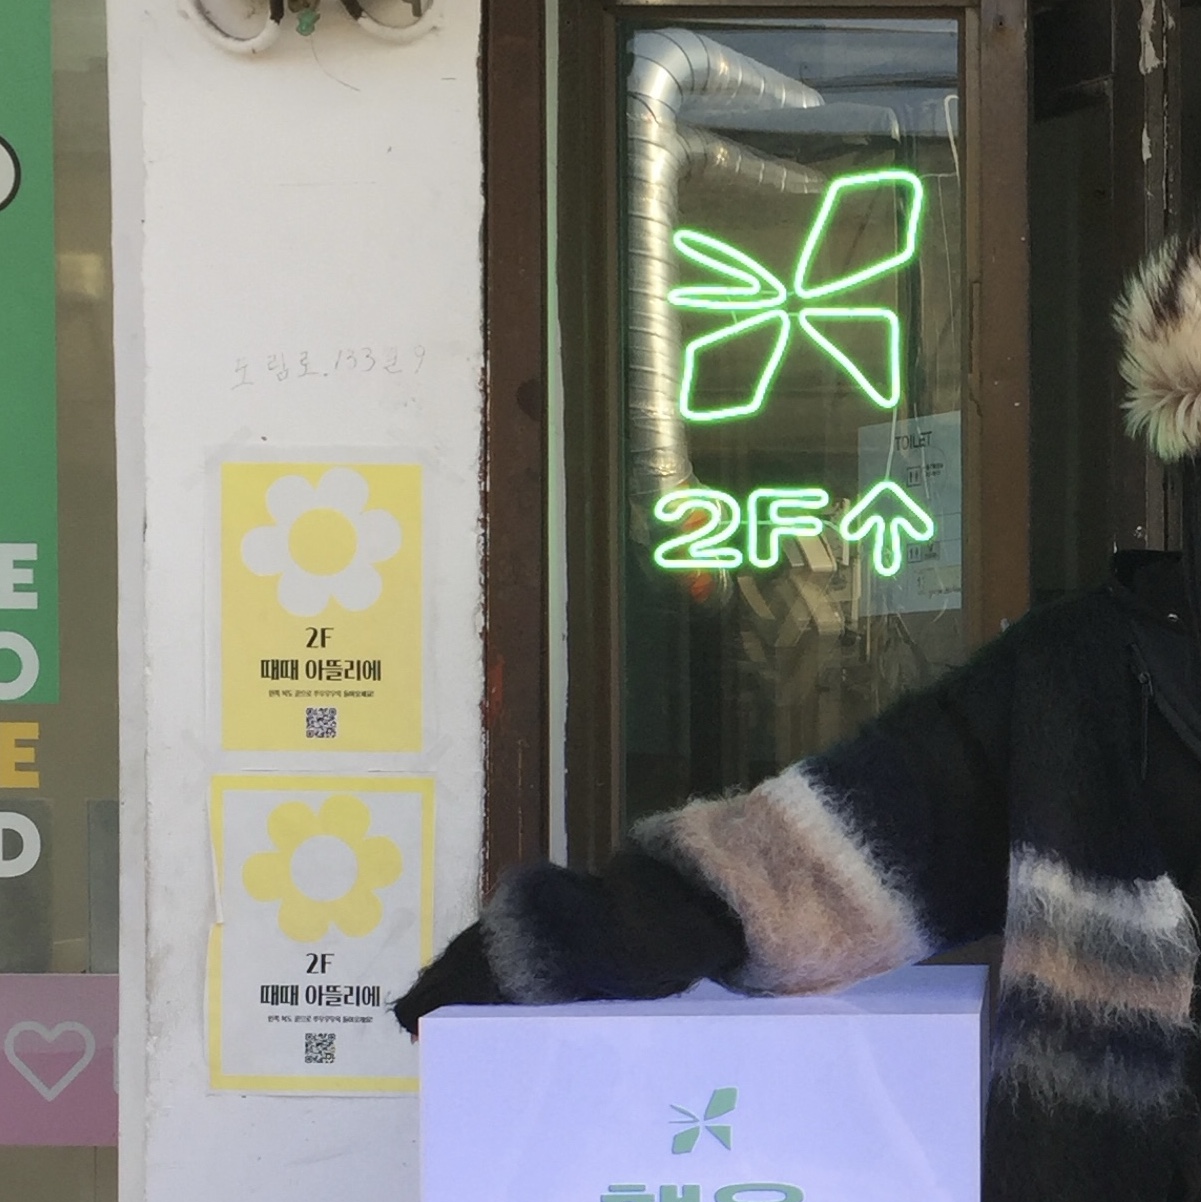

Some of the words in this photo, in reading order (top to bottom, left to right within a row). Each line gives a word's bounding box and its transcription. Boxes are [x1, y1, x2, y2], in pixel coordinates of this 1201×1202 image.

[895, 430, 933, 451] TOILET
[652, 487, 830, 570] 2F
[305, 627, 335, 648] 2F
[260, 659, 299, 680] 때때
[305, 659, 381, 681] 아뜰리에
[305, 952, 335, 975] 2F
[260, 985, 299, 1006] 때때
[305, 985, 380, 1007] 아뜰리에
